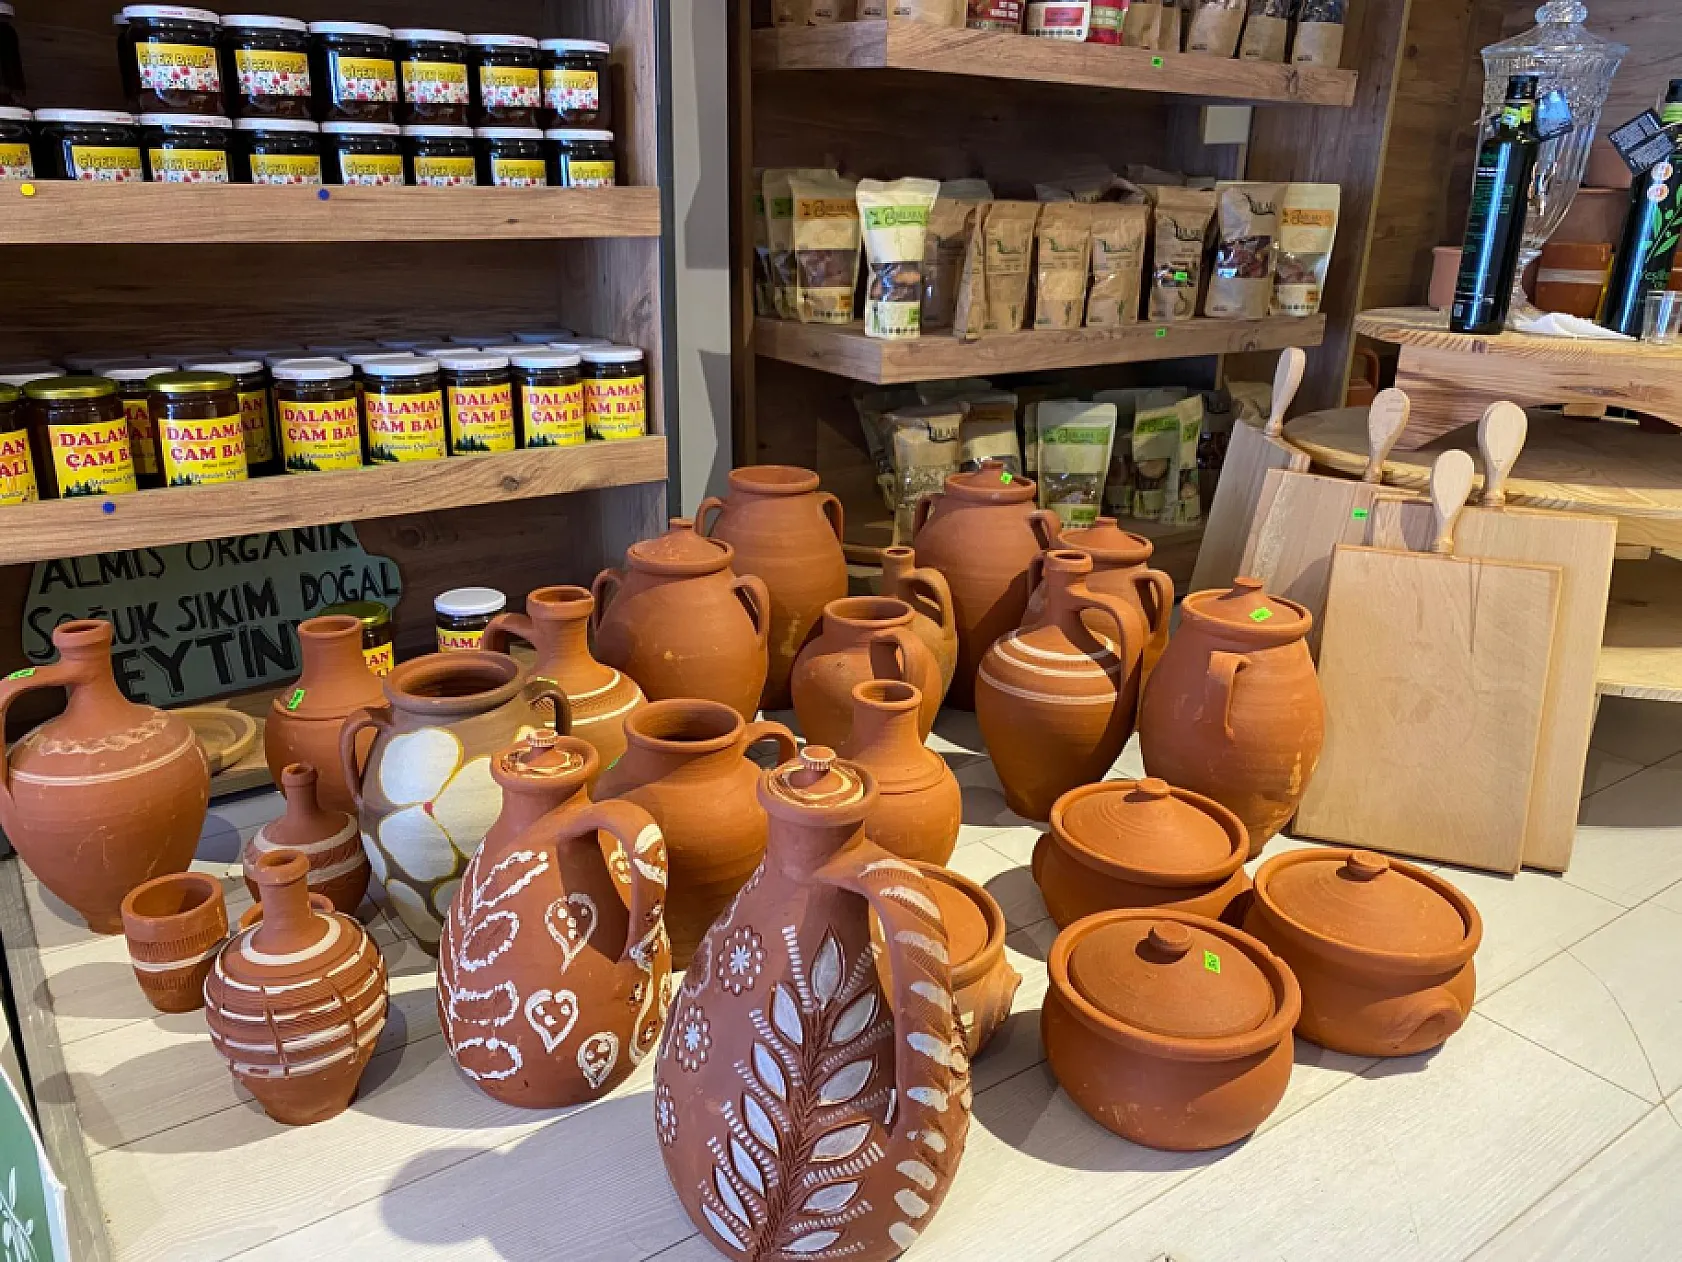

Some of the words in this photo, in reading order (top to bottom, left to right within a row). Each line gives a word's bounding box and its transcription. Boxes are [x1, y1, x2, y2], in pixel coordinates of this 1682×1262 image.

[287, 427, 327, 444] ÇAM
[332, 424, 358, 440] BAL
[65, 450, 115, 471] ÇAM
[171, 446, 216, 464] ÇAM
[299, 561, 401, 612] DOĞAL
